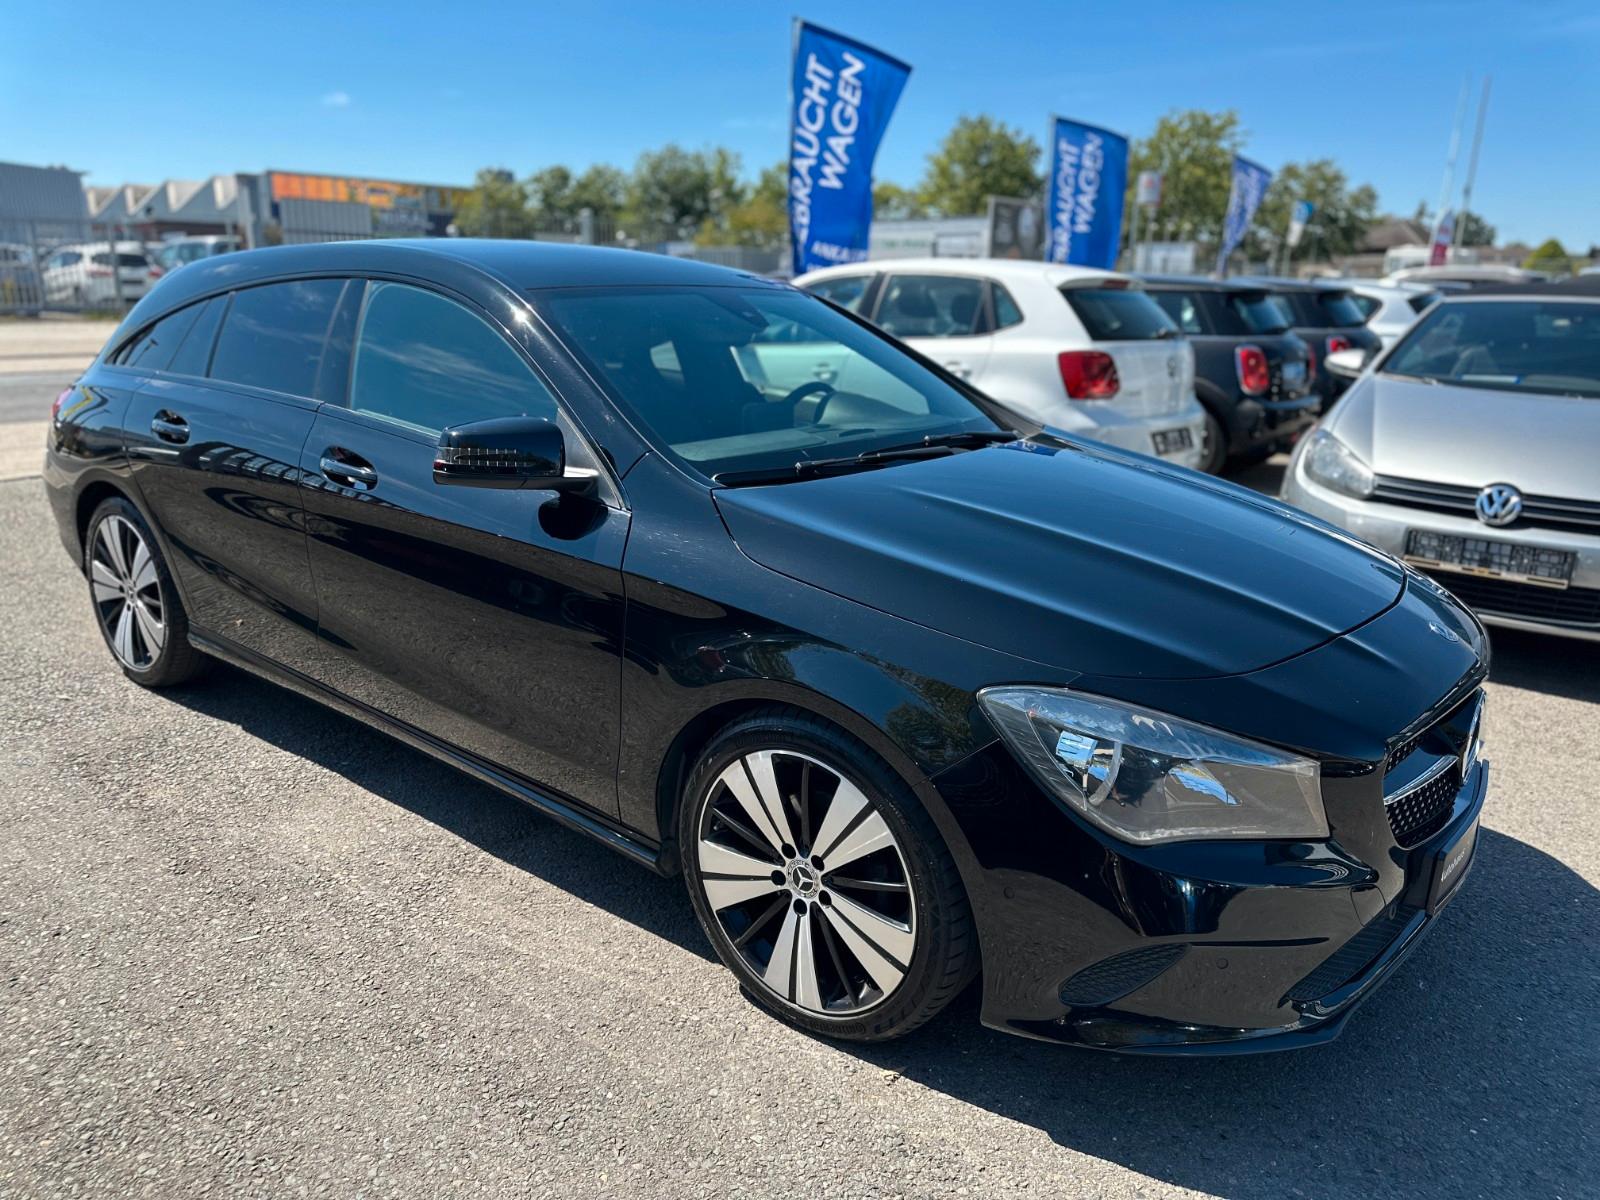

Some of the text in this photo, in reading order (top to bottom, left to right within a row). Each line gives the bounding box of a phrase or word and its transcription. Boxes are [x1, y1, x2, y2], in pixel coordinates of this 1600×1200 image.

[791, 53, 834, 243] BRAUCHT
[818, 52, 866, 189] WAGEN
[1075, 132, 1104, 233] WAGEN
[1053, 138, 1081, 262] BRAUCHT
